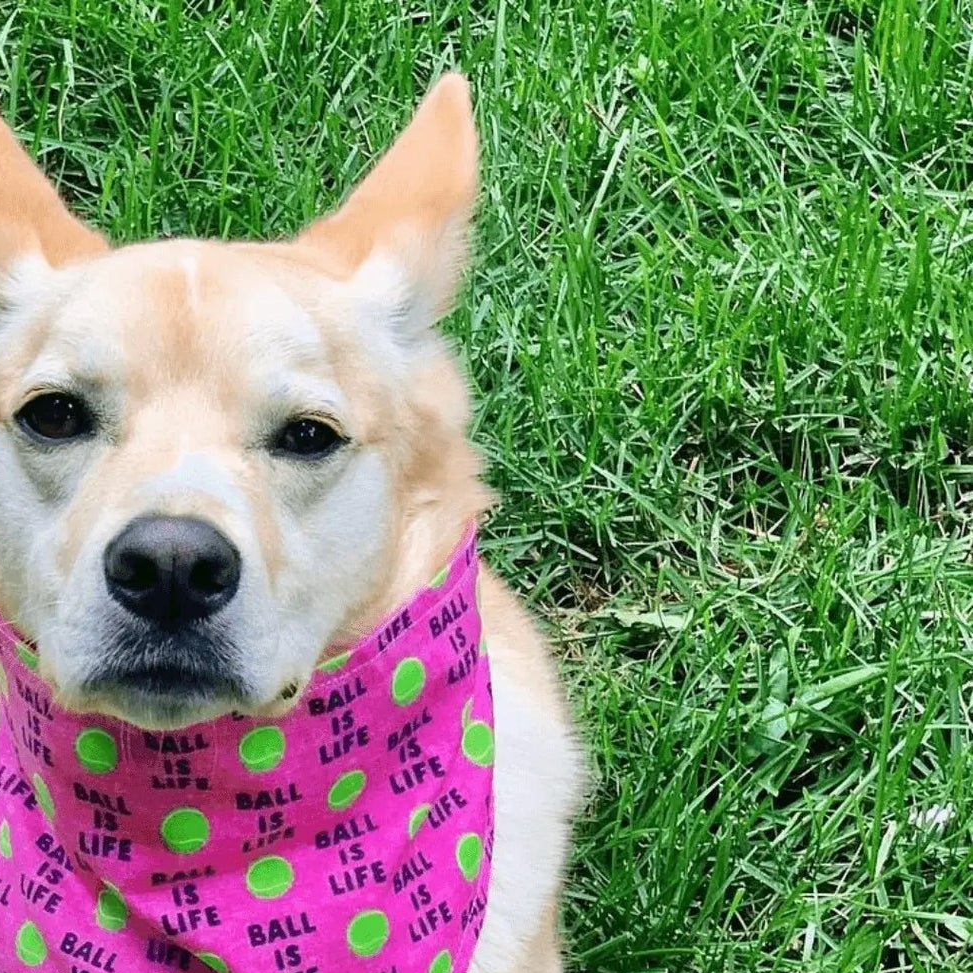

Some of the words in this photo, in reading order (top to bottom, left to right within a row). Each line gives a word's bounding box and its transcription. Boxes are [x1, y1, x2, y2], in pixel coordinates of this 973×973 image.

[377, 608, 413, 653] LIFE
[429, 592, 468, 639] BALL
[449, 626, 467, 654] IS
[308, 677, 367, 716] BALL
[331, 709, 355, 736] IS
[143, 731, 209, 754] BALL
[319, 725, 369, 765] LIFE
[399, 738, 422, 763] IS
[389, 756, 446, 795] LIFE
[73, 782, 132, 816] BALL
[235, 783, 302, 811] BALL
[427, 788, 468, 829] LIFE
[93, 809, 119, 832] IS
[258, 811, 284, 834] IS
[314, 814, 378, 850] BALL
[79, 831, 132, 862] LIFE
[339, 843, 365, 865] IS
[37, 861, 63, 885] IS
[329, 861, 387, 896] LIFE
[393, 851, 433, 894] BALL
[20, 874, 63, 914] LIFE
[172, 883, 200, 907] IS
[410, 884, 432, 912] IS
[161, 905, 222, 936] LIFE
[247, 912, 317, 948] BALL
[409, 901, 452, 942] LIFE
[60, 931, 118, 973] BALL
[274, 944, 303, 971] IS
